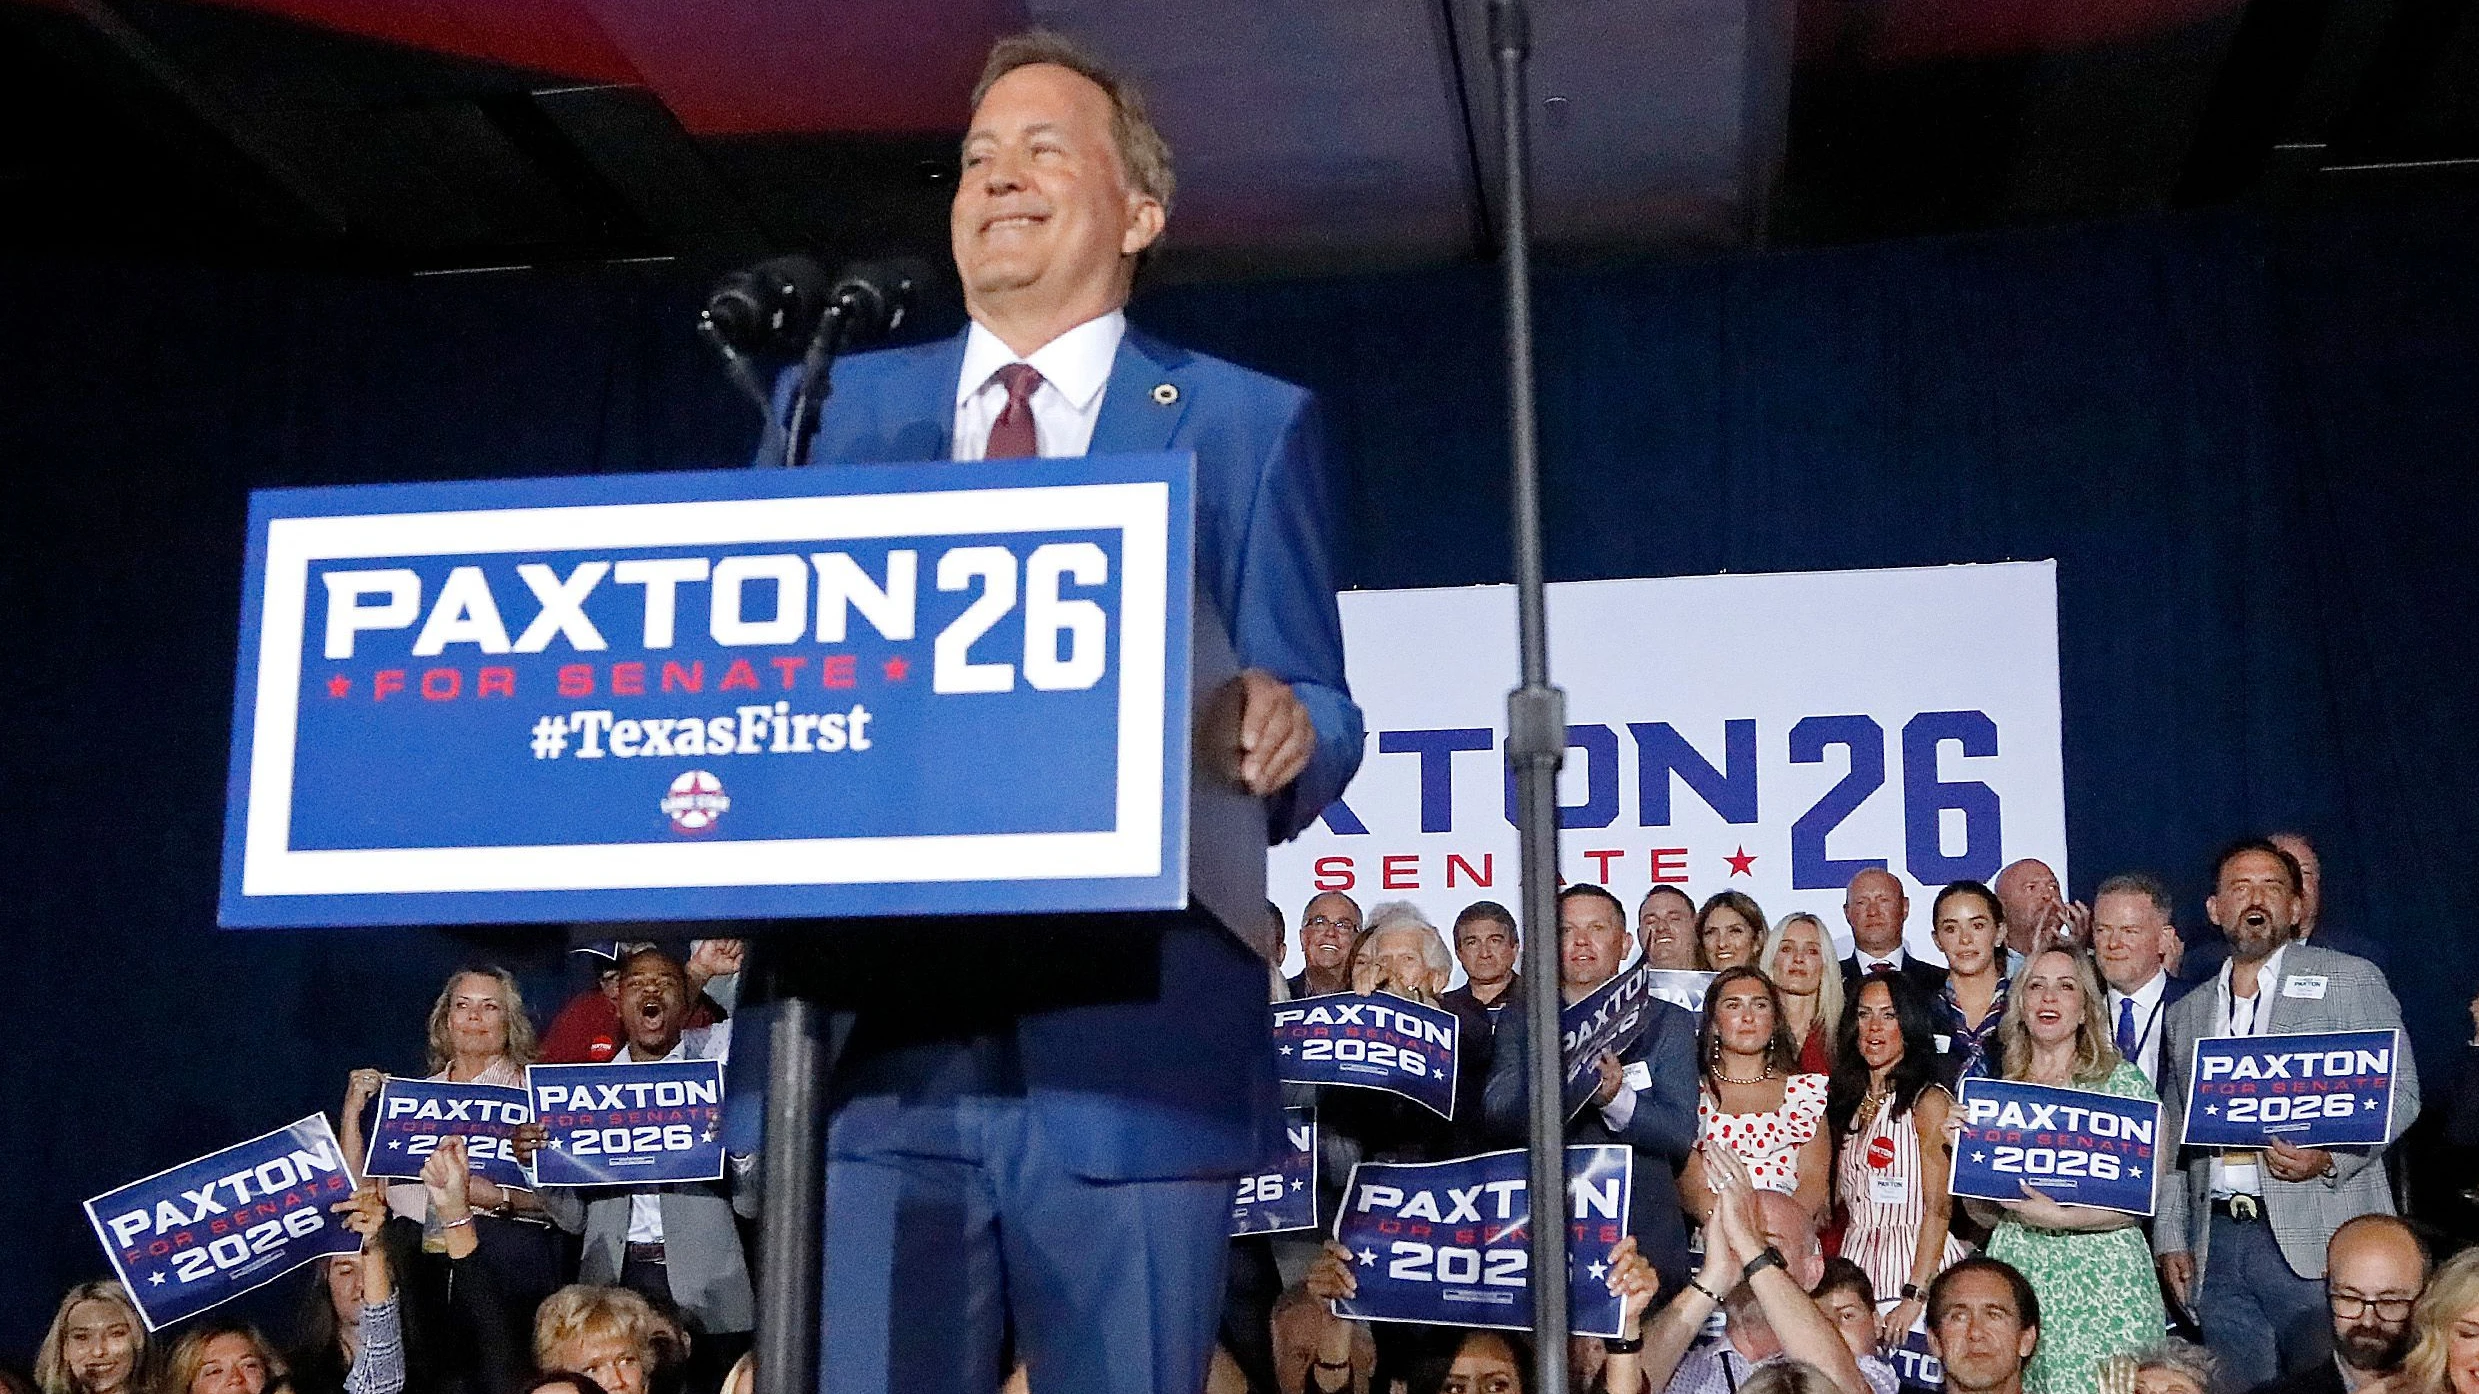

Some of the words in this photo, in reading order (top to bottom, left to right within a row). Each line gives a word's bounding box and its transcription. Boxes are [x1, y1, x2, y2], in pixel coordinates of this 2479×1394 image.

[323, 549, 917, 660] PAXTON
[933, 542, 1108, 695] 26
[373, 667, 515, 701] FOR
[558, 655, 857, 696] SENATE
[531, 701, 872, 760] #TexasFirst
[1788, 710, 2002, 890] 26
[1314, 848, 1689, 891] SENTE
[1273, 1027, 1329, 1038] FOR
[1346, 1027, 1450, 1061] SENATE
[1274, 1004, 1452, 1051] PAXTON
[1302, 1039, 1427, 1077] 2026
[2202, 1049, 2389, 1081] PAXTON
[536, 1079, 718, 1112] PAXTON
[2200, 1083, 2258, 1094] FOR
[2272, 1078, 2388, 1093] SENATE
[540, 1114, 593, 1127] FOR
[1968, 1098, 2153, 1145] PAXTON
[2227, 1093, 2355, 1122] 2026
[407, 1135, 517, 1163] 226
[570, 1124, 693, 1155] 2026
[1966, 1129, 2022, 1144] FOR
[2037, 1133, 2151, 1159] SENATE
[1992, 1146, 2121, 1181] 2026
[107, 1140, 338, 1249] PAXTON
[1357, 1179, 1621, 1225] PAXTN
[126, 1231, 194, 1265] FOR
[210, 1176, 345, 1235] SENATE
[1455, 1225, 1619, 1245] SENTE
[171, 1205, 325, 1284] 2026
[1389, 1241, 1574, 1287] 202
